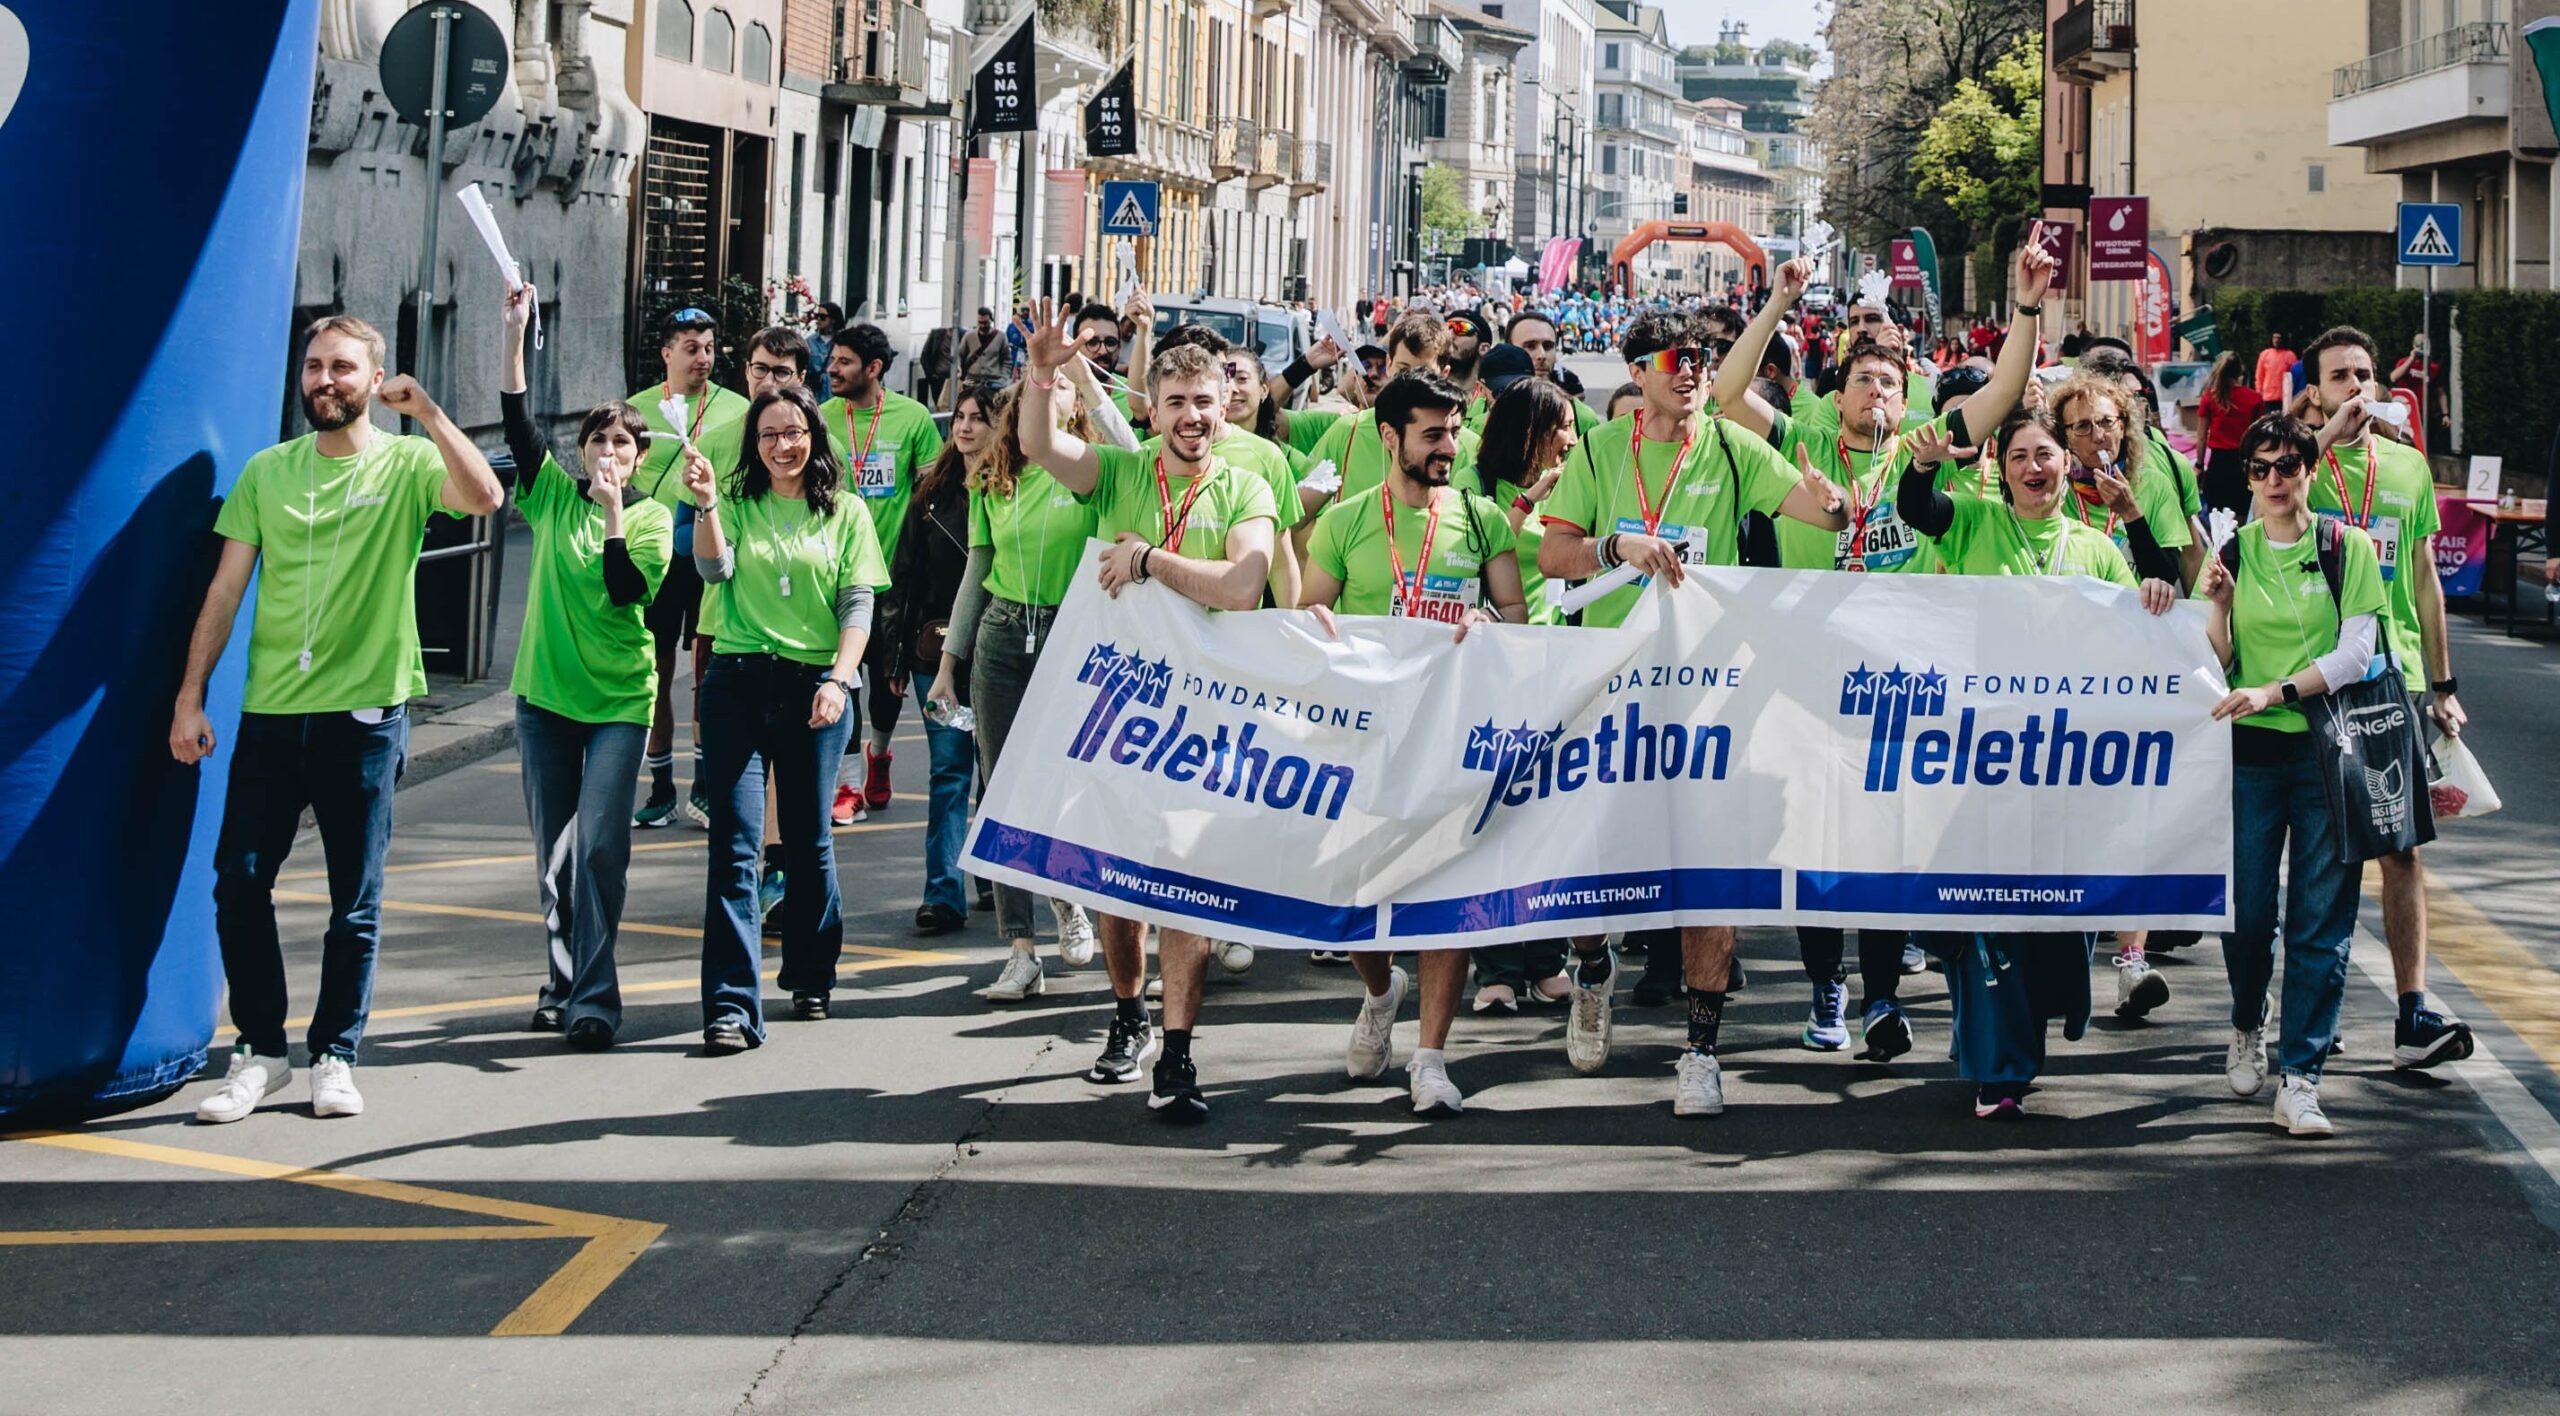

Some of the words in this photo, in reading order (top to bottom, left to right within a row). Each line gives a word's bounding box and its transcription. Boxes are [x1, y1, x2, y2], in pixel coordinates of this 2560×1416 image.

[994, 61, 1016, 75] SE
[994, 79, 1018, 92] NA
[995, 95, 1018, 108] TO
[1101, 97, 1120, 108] SE
[1101, 111, 1121, 122] NA
[1102, 125, 1121, 136] TO
[2092, 261, 2144, 269] INTEGRATORE
[2476, 470, 2490, 491] 2
[2439, 535, 2467, 548] AIR
[1606, 666, 1742, 695] DAZIONE
[1964, 675, 2182, 695] FONDAZIONE
[1183, 672, 1373, 731] FONDAZIONE
[1066, 641, 1355, 820] Telethon
[1840, 660, 2174, 792] Telethon
[1462, 702, 1732, 836] Telethon
[1101, 867, 1238, 911] WWW.TELETHON.IT
[1527, 885, 1662, 910] WWW.TELETHON.IT
[1937, 887, 2084, 904] WWW.TELETHON.IT
